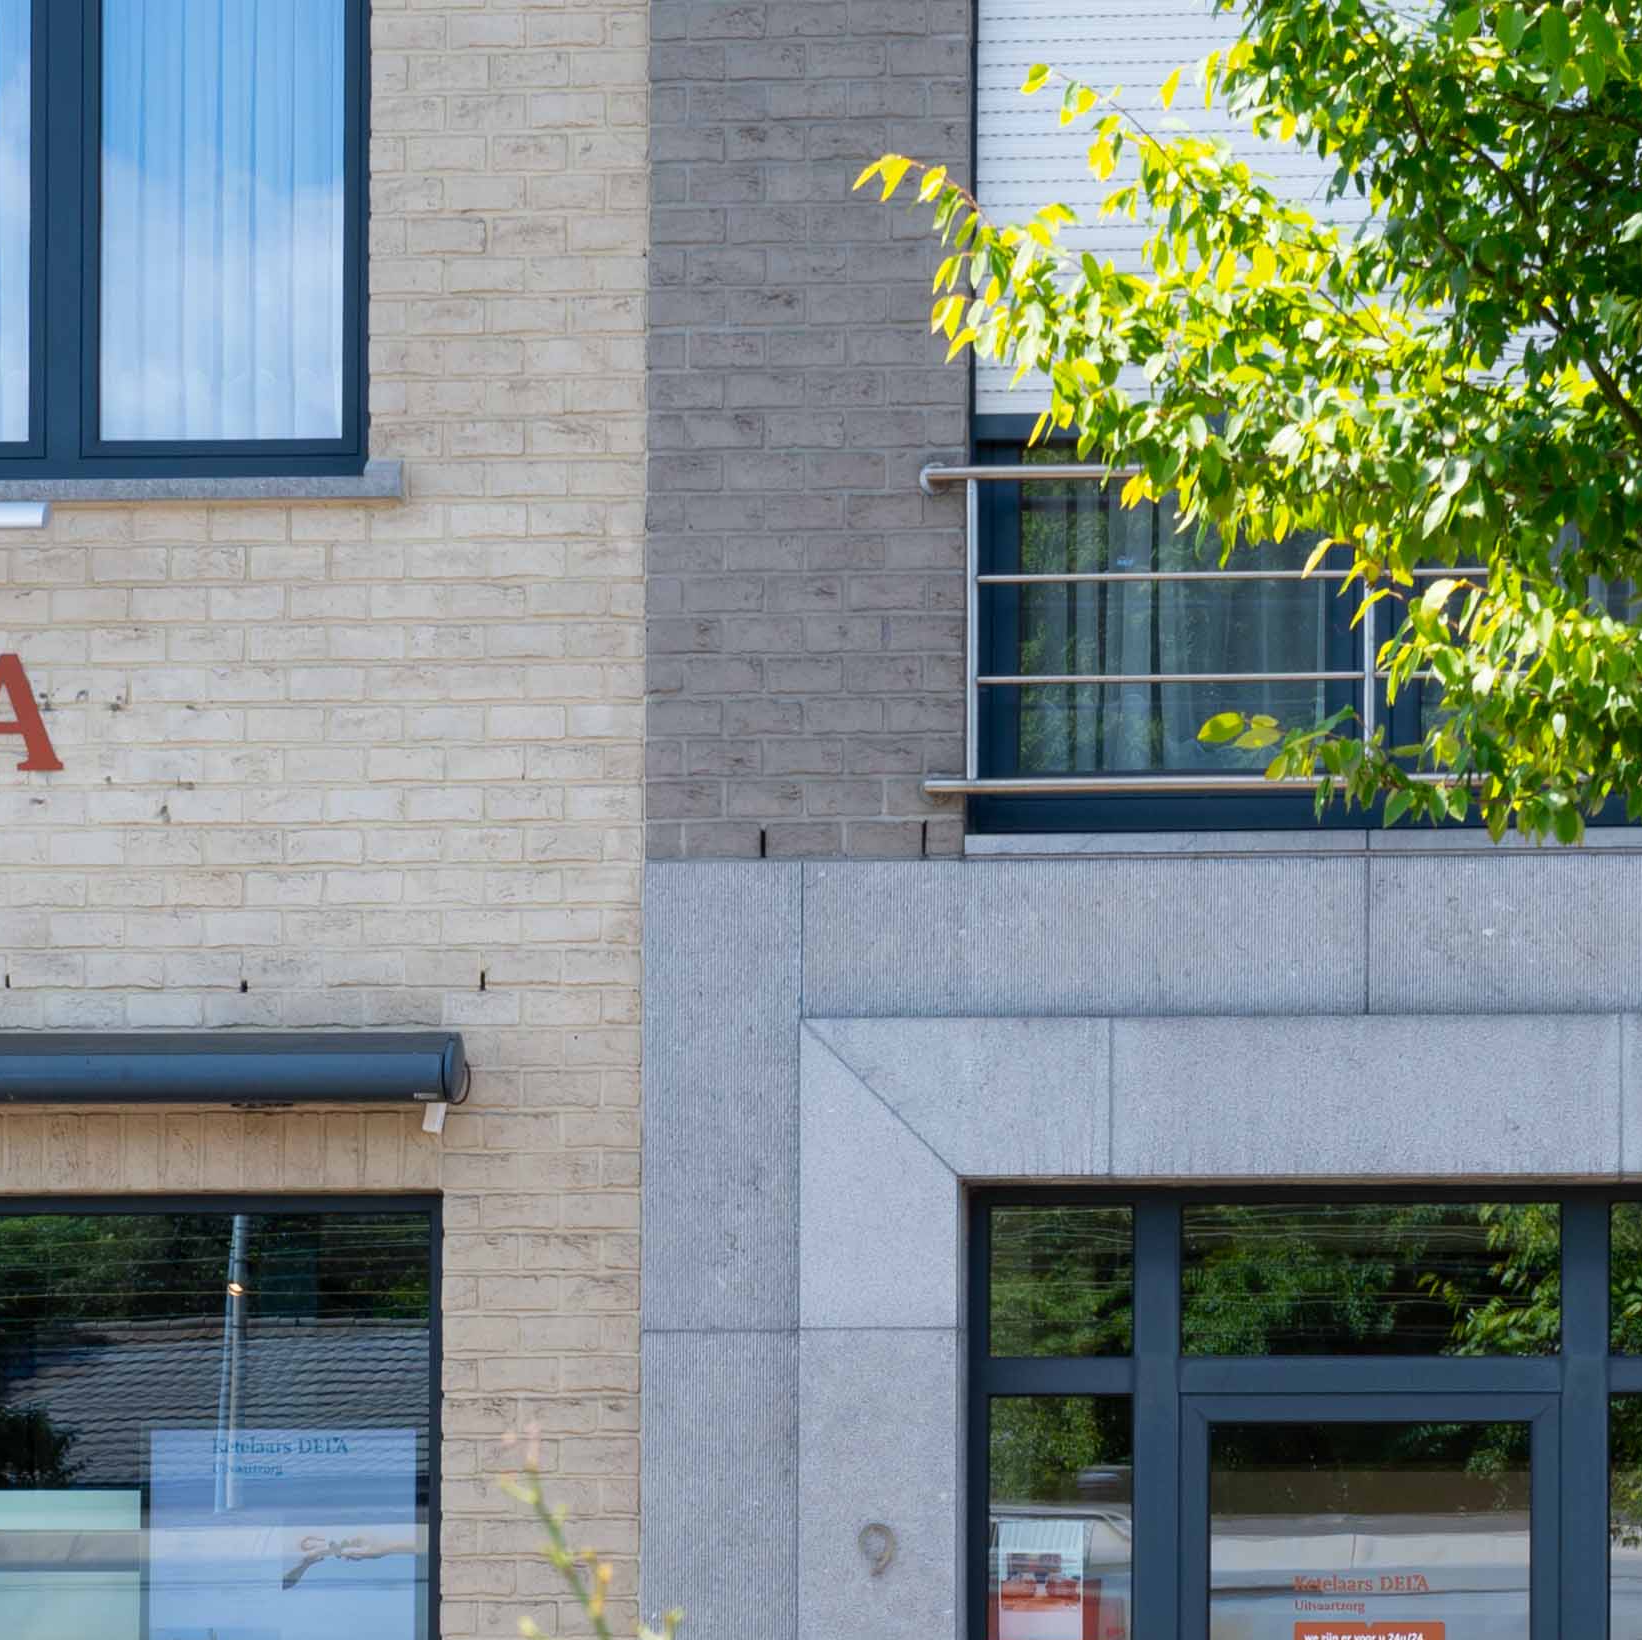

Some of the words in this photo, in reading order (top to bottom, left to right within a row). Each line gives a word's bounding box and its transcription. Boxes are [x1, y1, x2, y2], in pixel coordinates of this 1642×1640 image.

[1294, 1573, 1373, 1592] Ketelaars
[1380, 1574, 1430, 1591] DELA
[1295, 1600, 1366, 1614] Uitvaartzorg
